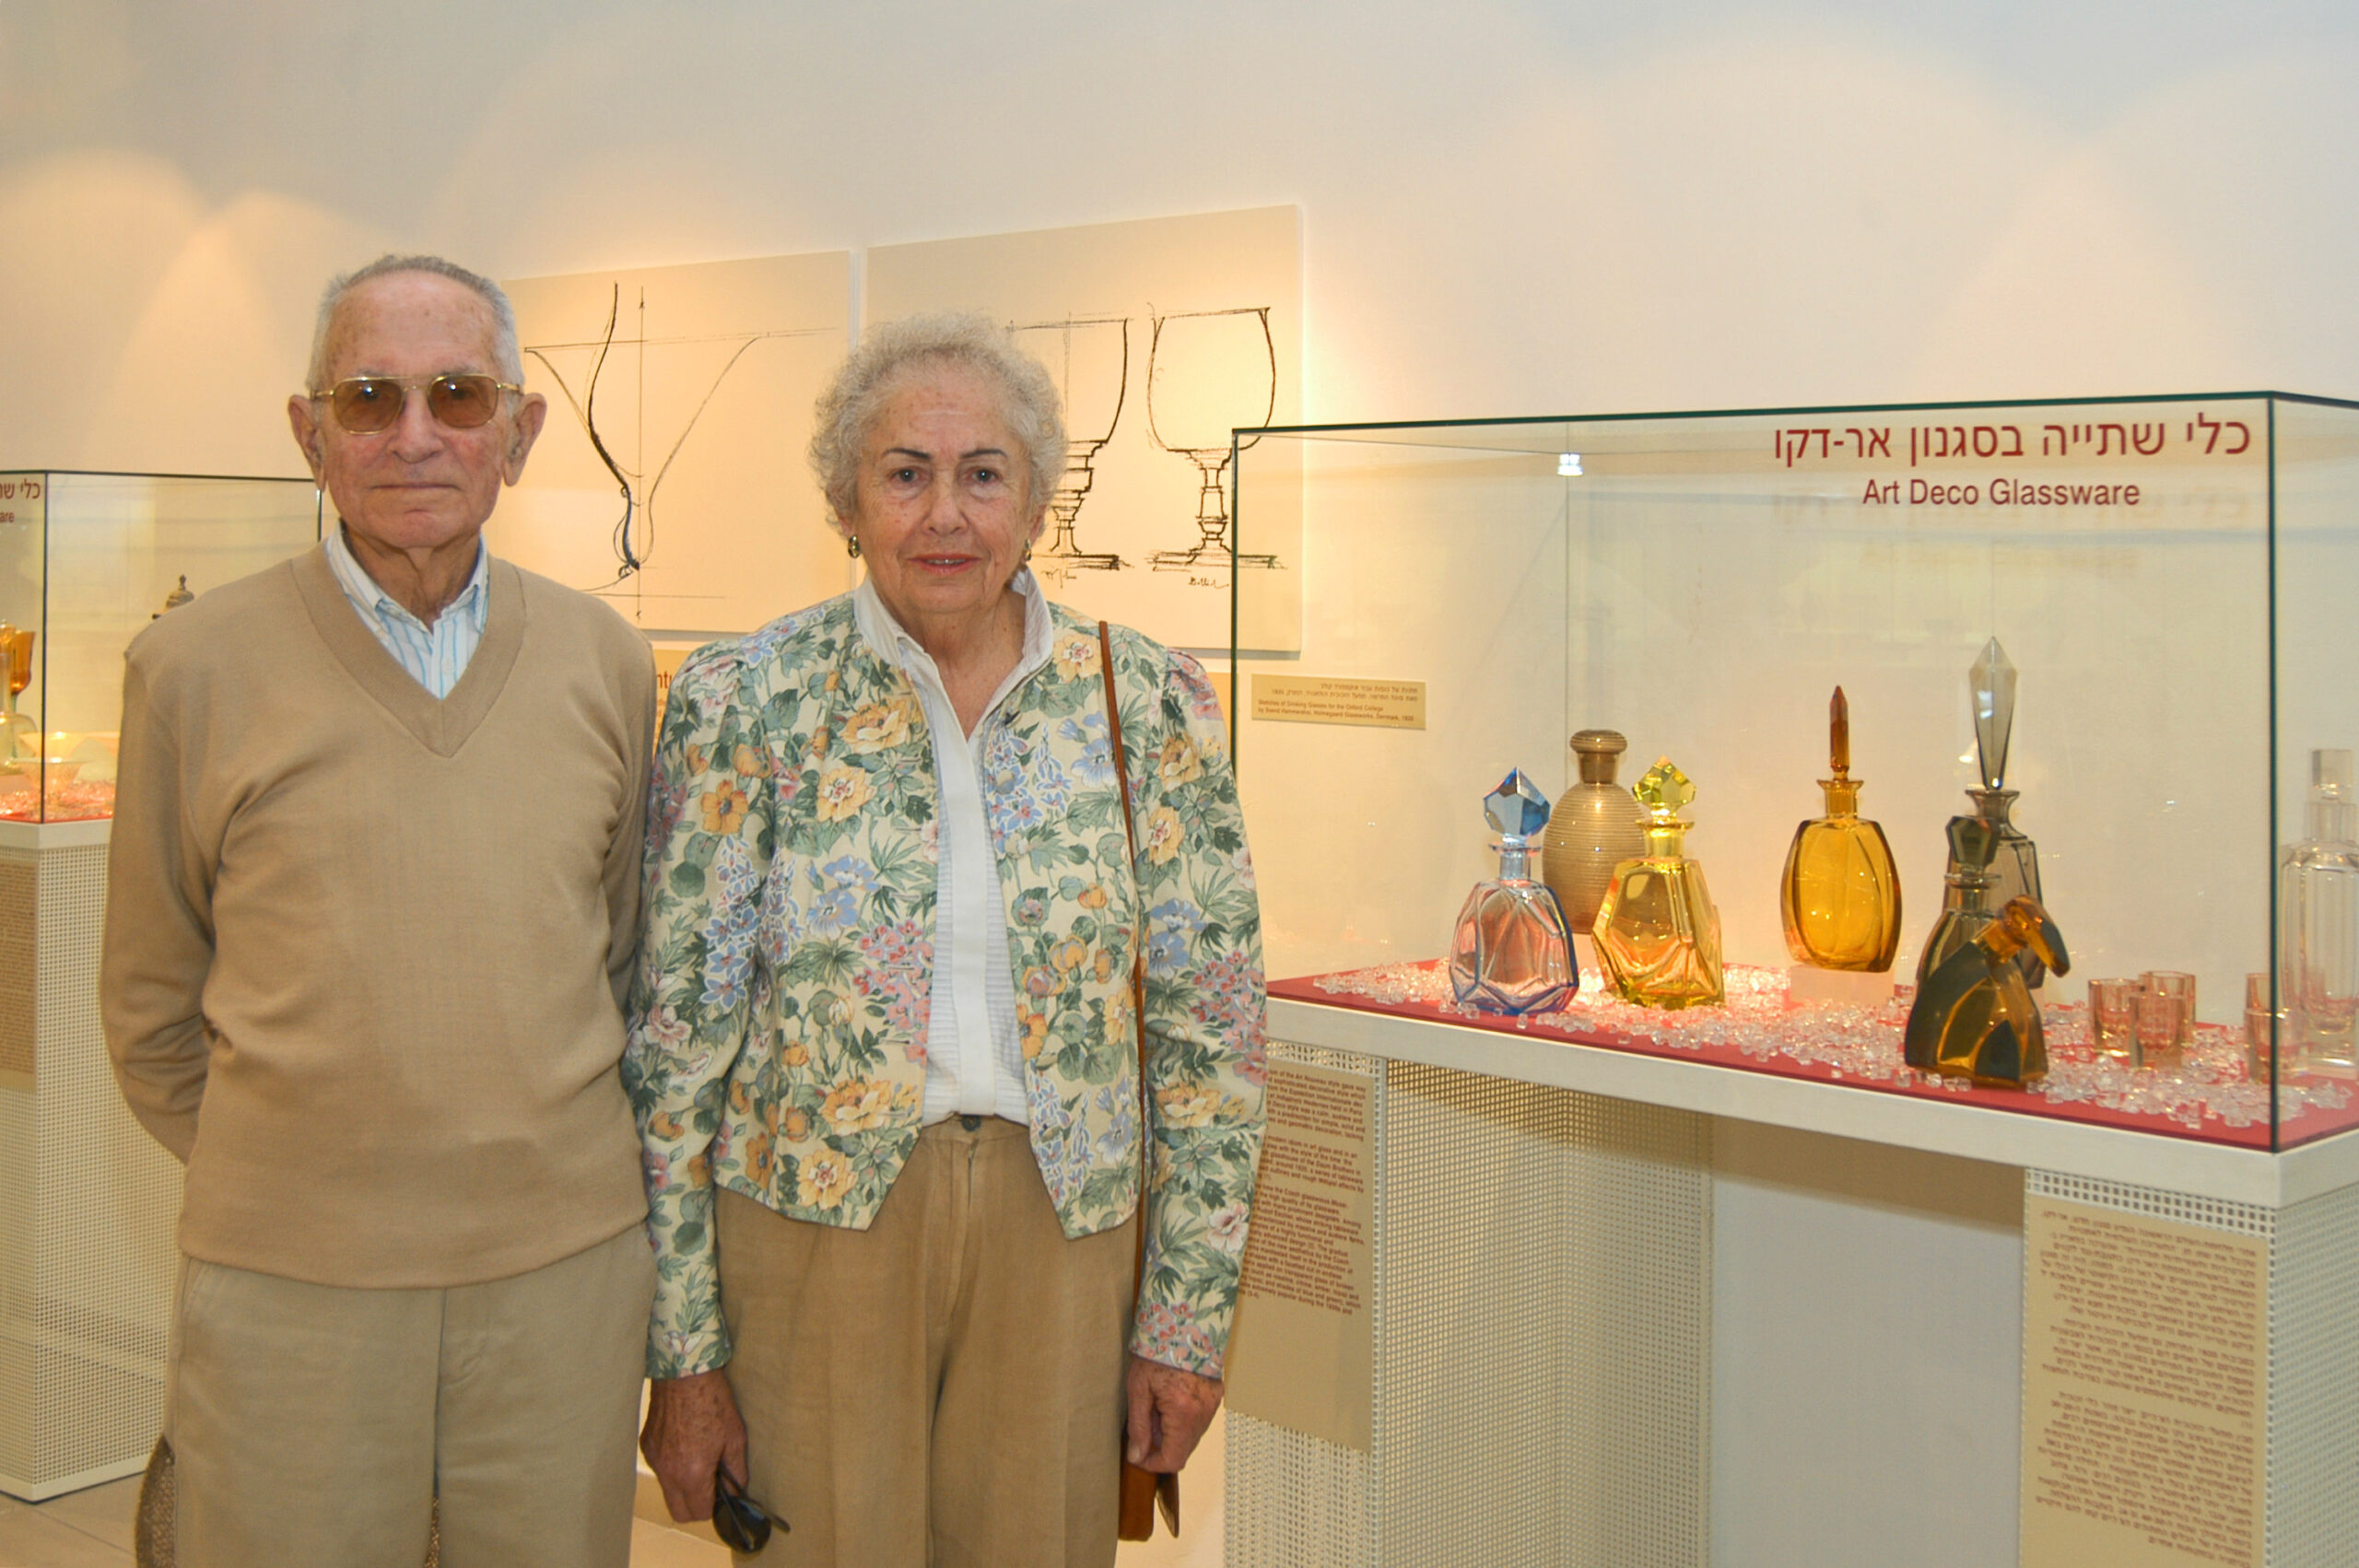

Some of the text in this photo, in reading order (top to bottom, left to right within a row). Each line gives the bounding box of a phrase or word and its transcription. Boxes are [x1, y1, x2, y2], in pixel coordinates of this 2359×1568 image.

[1775, 412, 2250, 468] כלי שתייה בסגנון אר-דקו
[20, 477, 41, 499] כלי
[1862, 478, 2141, 506] Art Deco Glassware
